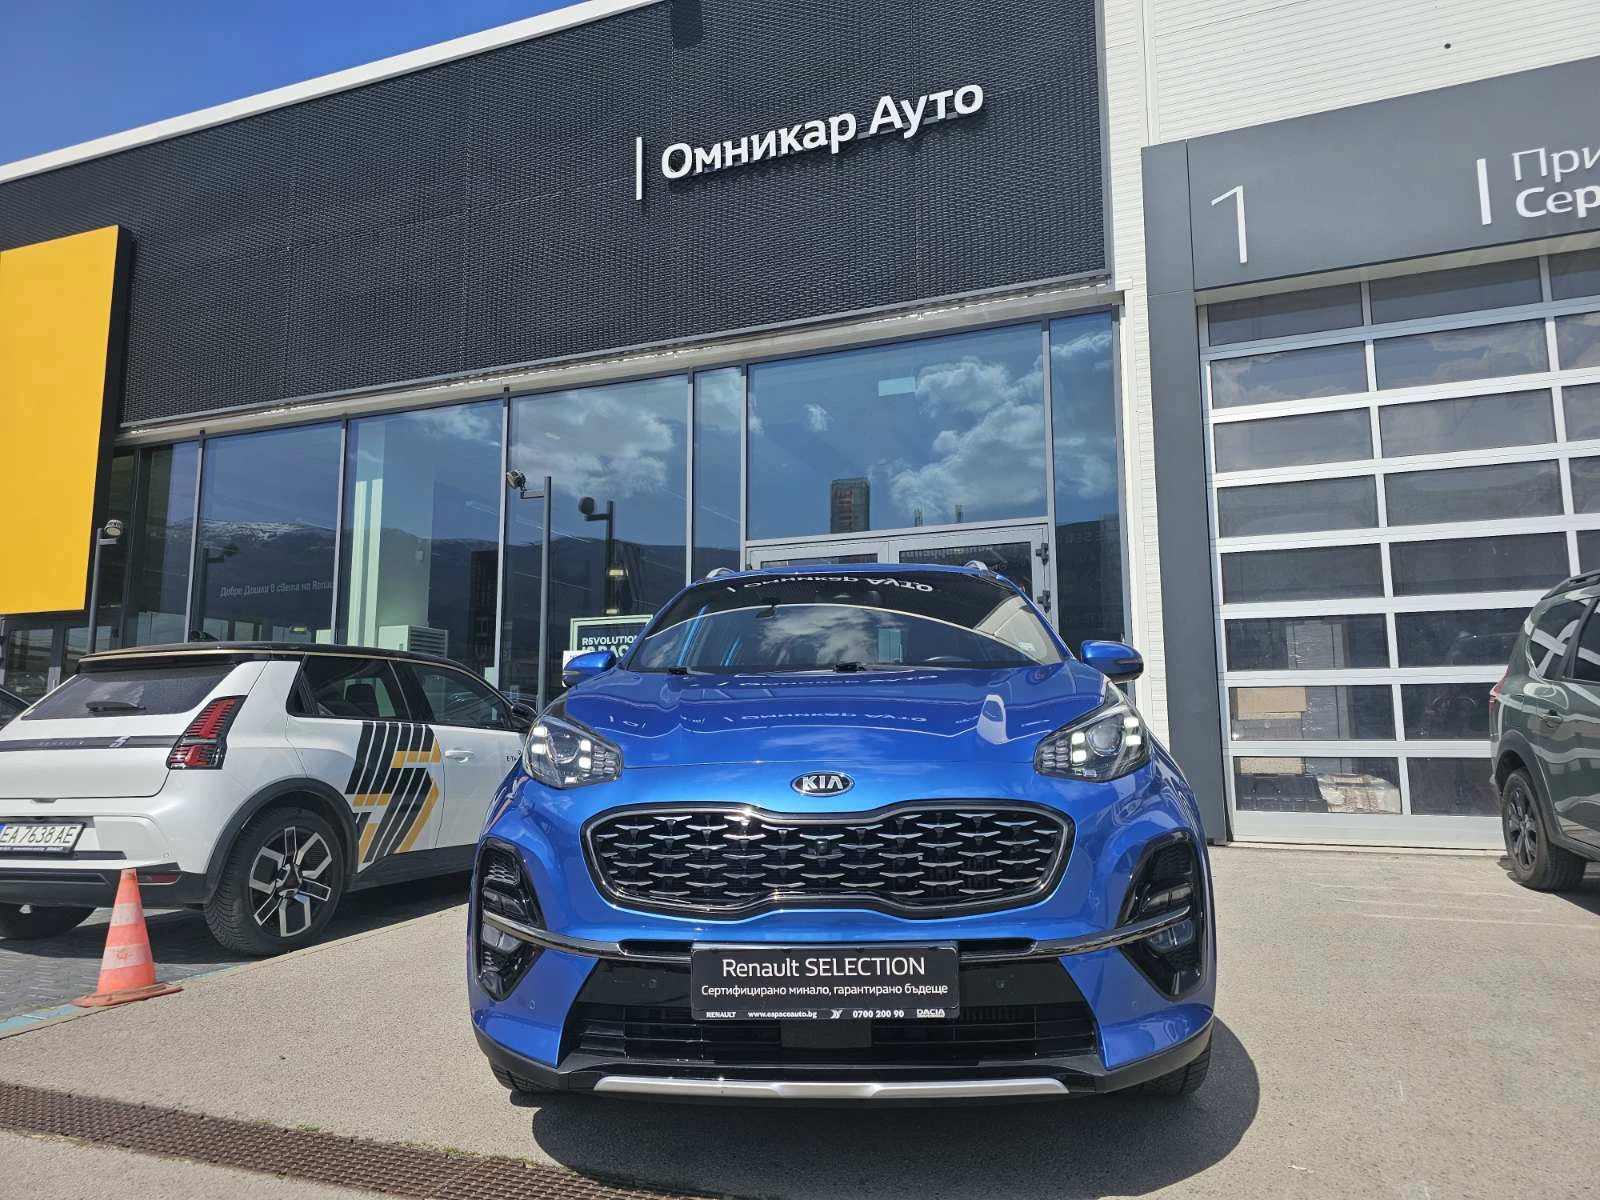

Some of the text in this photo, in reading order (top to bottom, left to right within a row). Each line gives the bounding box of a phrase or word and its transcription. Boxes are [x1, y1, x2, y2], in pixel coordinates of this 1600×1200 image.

[661, 84, 984, 180] Омникар Ауто
[1514, 184, 1600, 219] Сер
[1210, 184, 1248, 264] 1
[802, 775, 844, 790] KIA
[722, 957, 925, 977] Renault SELECTION
[701, 983, 949, 997] Сертифицирано минало, гарантирано бъдеще
[852, 1009, 875, 1018] 0700
[876, 1009, 893, 1018] 200
[893, 1009, 905, 1018] 90
[916, 1008, 946, 1018] DACIA
